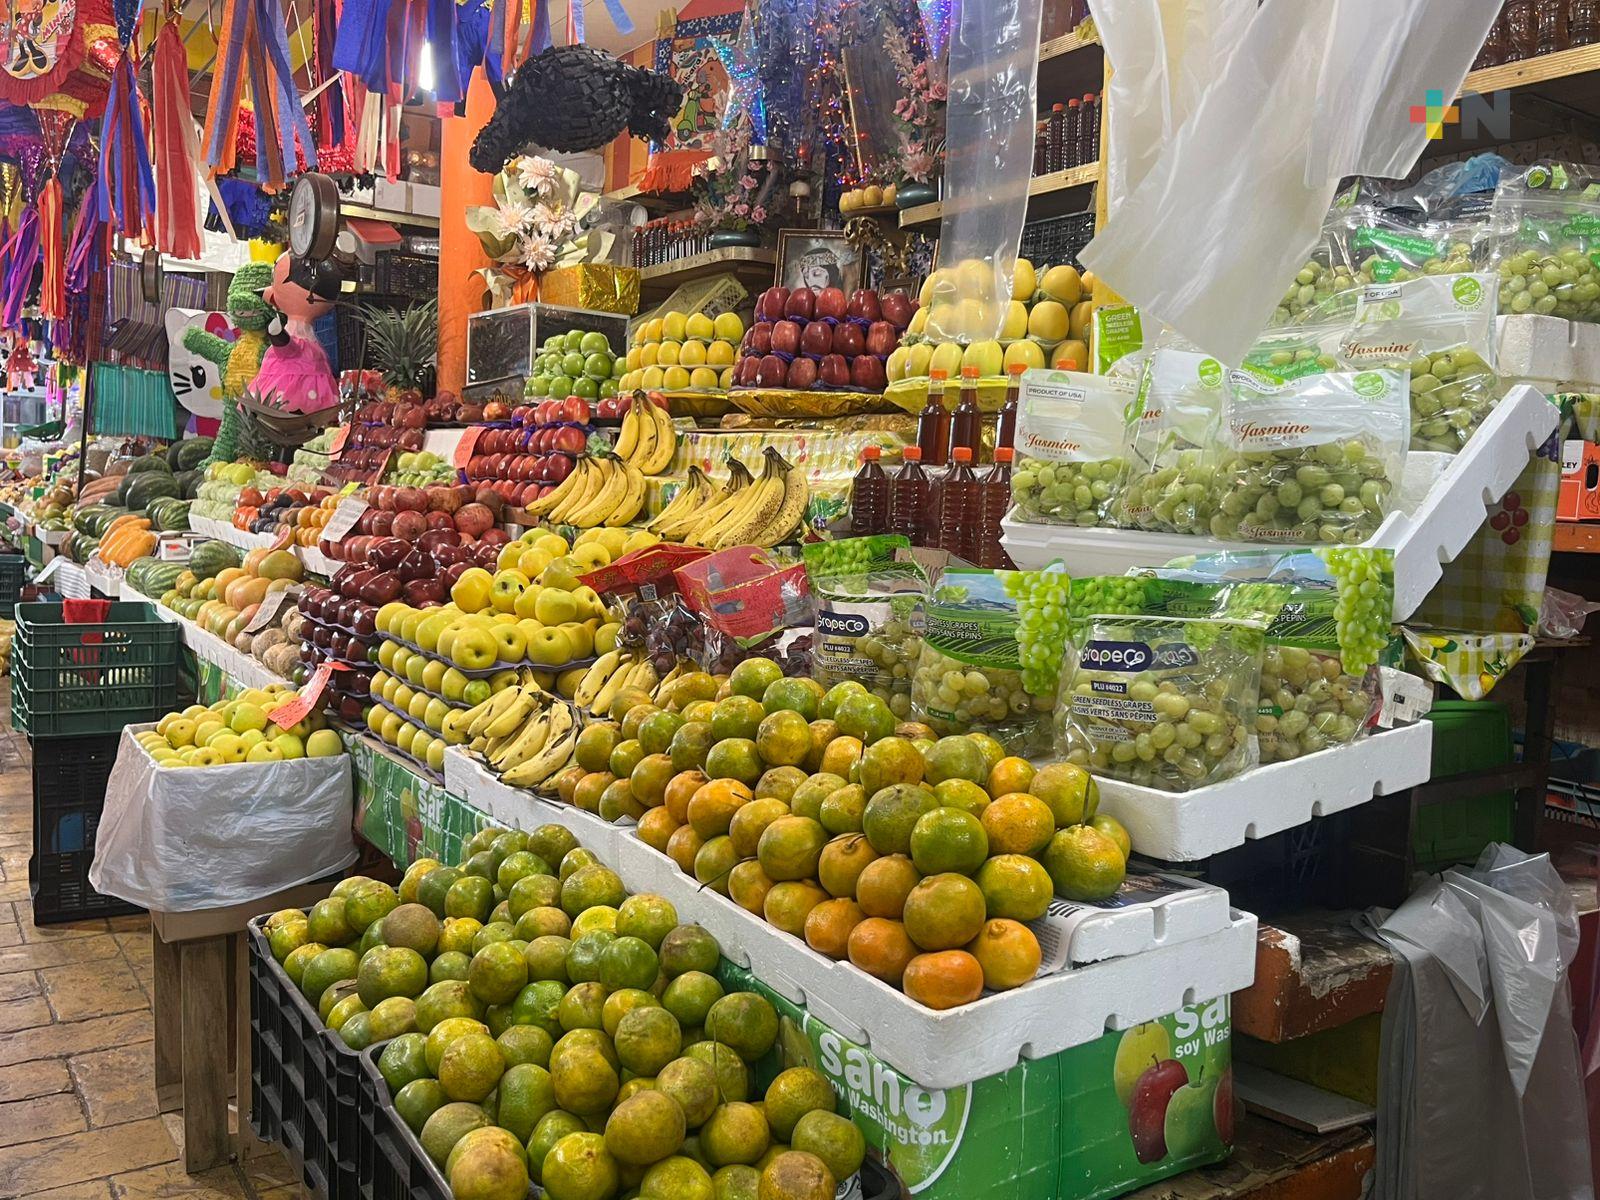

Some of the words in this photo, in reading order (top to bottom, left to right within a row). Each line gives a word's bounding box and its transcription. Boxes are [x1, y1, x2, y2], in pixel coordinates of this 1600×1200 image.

[1105, 313, 1131, 322] GREEN
[1344, 342, 1413, 359] Jasmine
[1028, 388, 1058, 396] PRODUCT
[1238, 421, 1311, 443] Jasmine
[1025, 432, 1081, 452] Jasmine
[1248, 526, 1306, 539] Jasmine
[950, 621, 978, 631] GRAPES
[1093, 682, 1105, 691] PLU
[1073, 696, 1091, 704] GREEN
[1091, 698, 1122, 708] SEEDLESS
[1122, 701, 1152, 710] GRAPES
[1090, 708, 1110, 718] VERTS
[1110, 711, 1129, 719] SANS
[1129, 711, 1157, 721] PÉPINS
[1175, 1038, 1200, 1059] soy
[819, 1032, 947, 1129] sano
[847, 1086, 950, 1146] Washington
